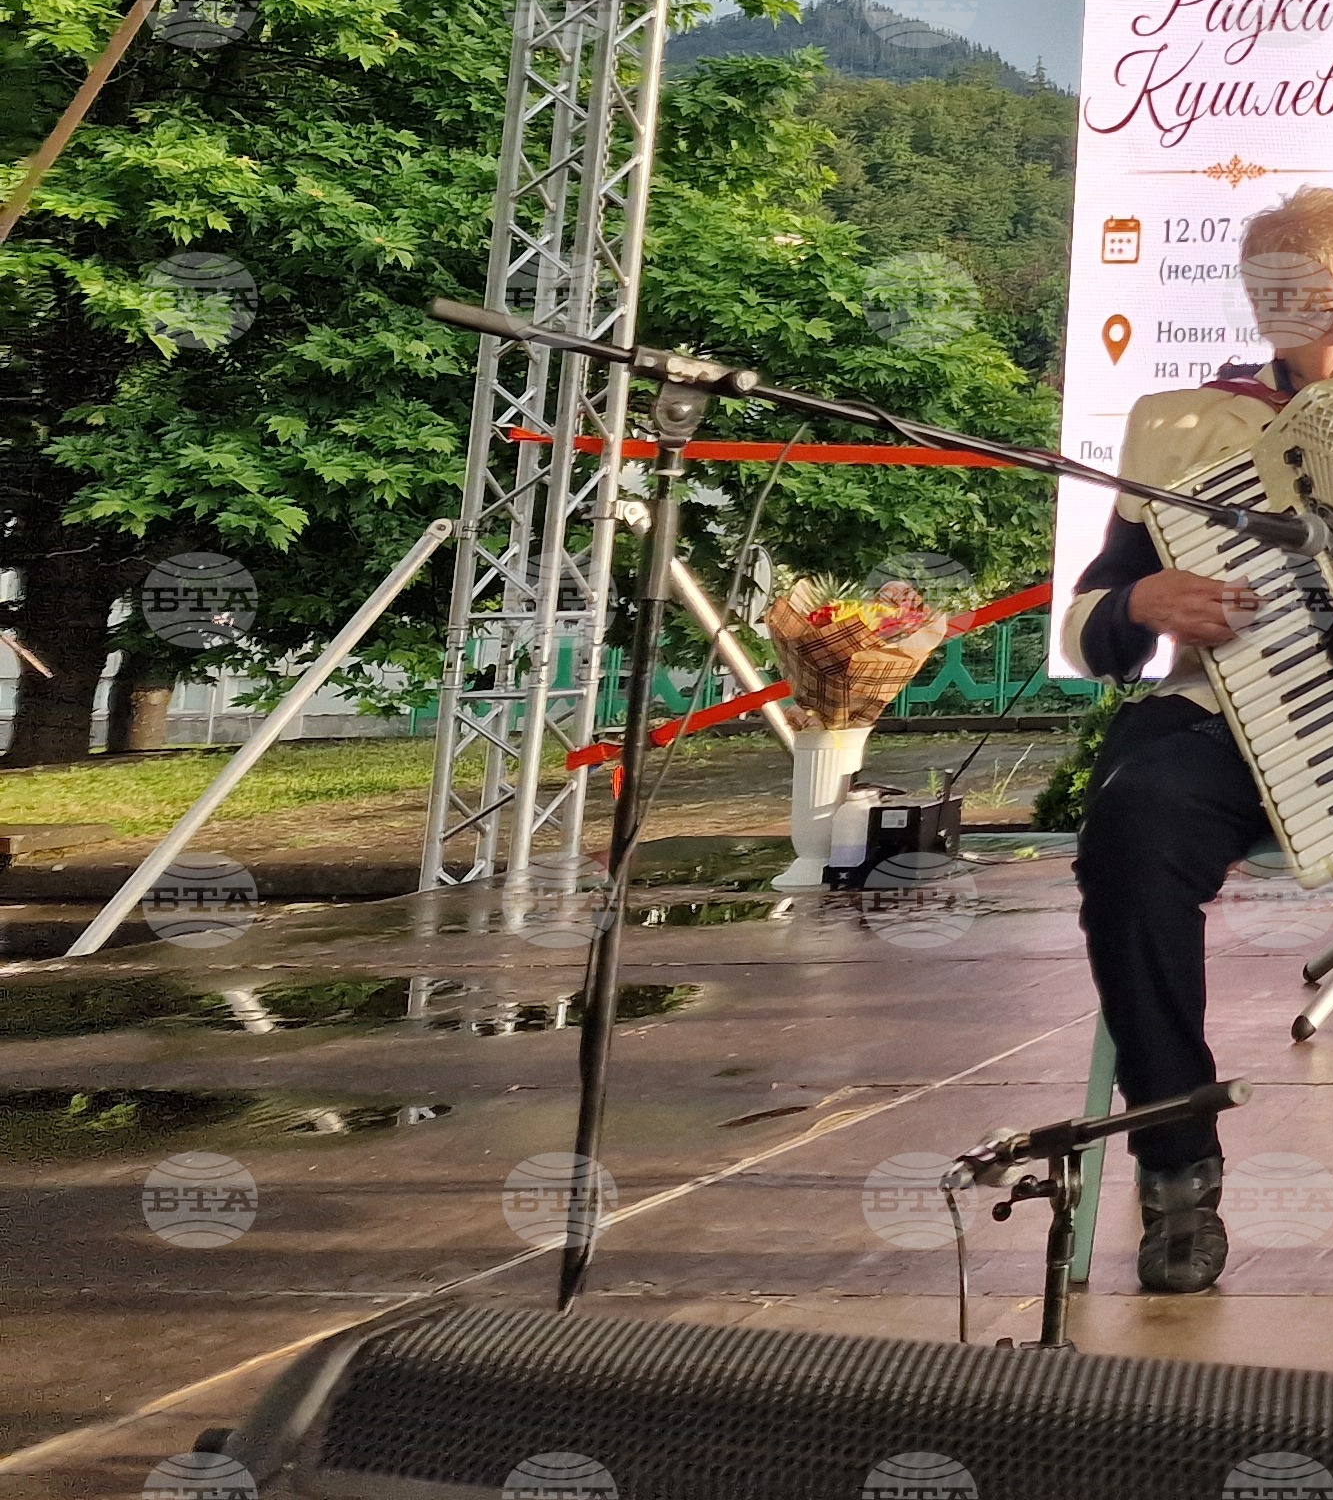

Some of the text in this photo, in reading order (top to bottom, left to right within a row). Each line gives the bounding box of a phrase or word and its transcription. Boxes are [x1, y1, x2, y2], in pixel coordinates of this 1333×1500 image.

[1163, 218, 1240, 243] 12.07.
[1157, 320, 1259, 347] Новия це
[1154, 362, 1179, 378] на
[1080, 440, 1114, 463] Под
